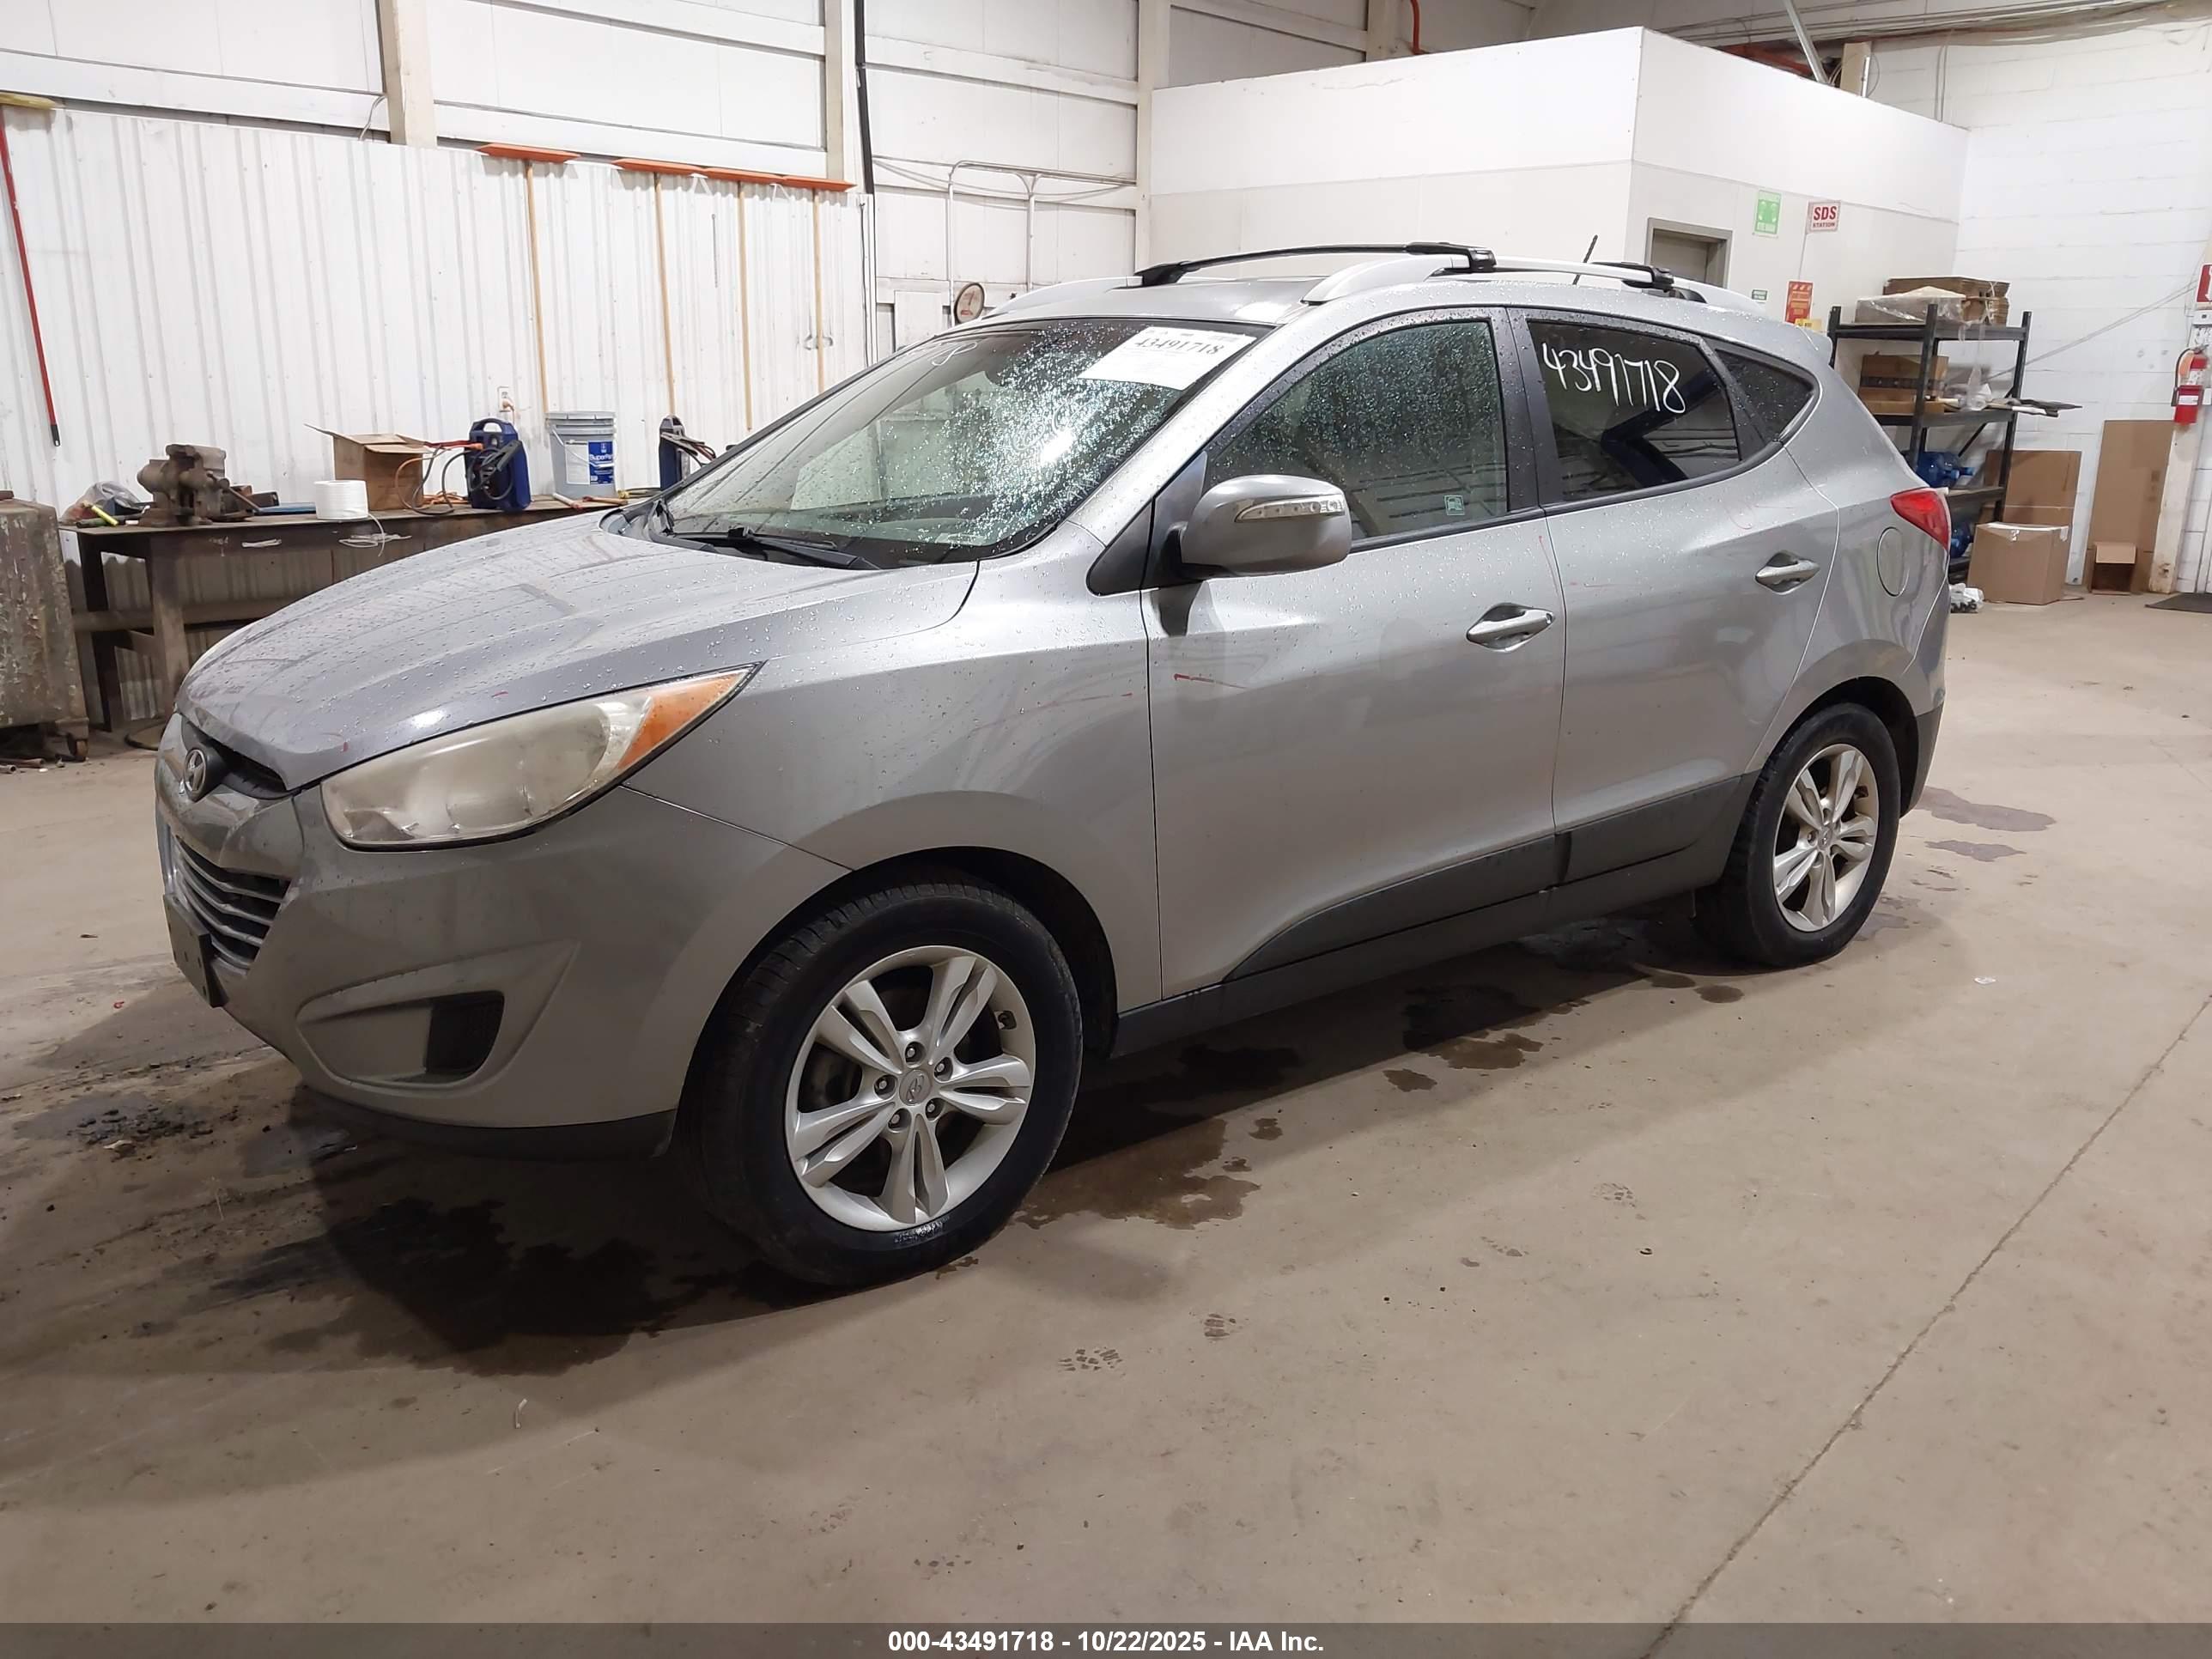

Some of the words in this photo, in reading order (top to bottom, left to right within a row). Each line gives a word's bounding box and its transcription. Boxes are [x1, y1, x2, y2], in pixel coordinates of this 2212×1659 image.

[1814, 206, 1837, 221] SDS
[1134, 337, 1225, 355] 43491718
[1541, 342, 1686, 413] 43491718
